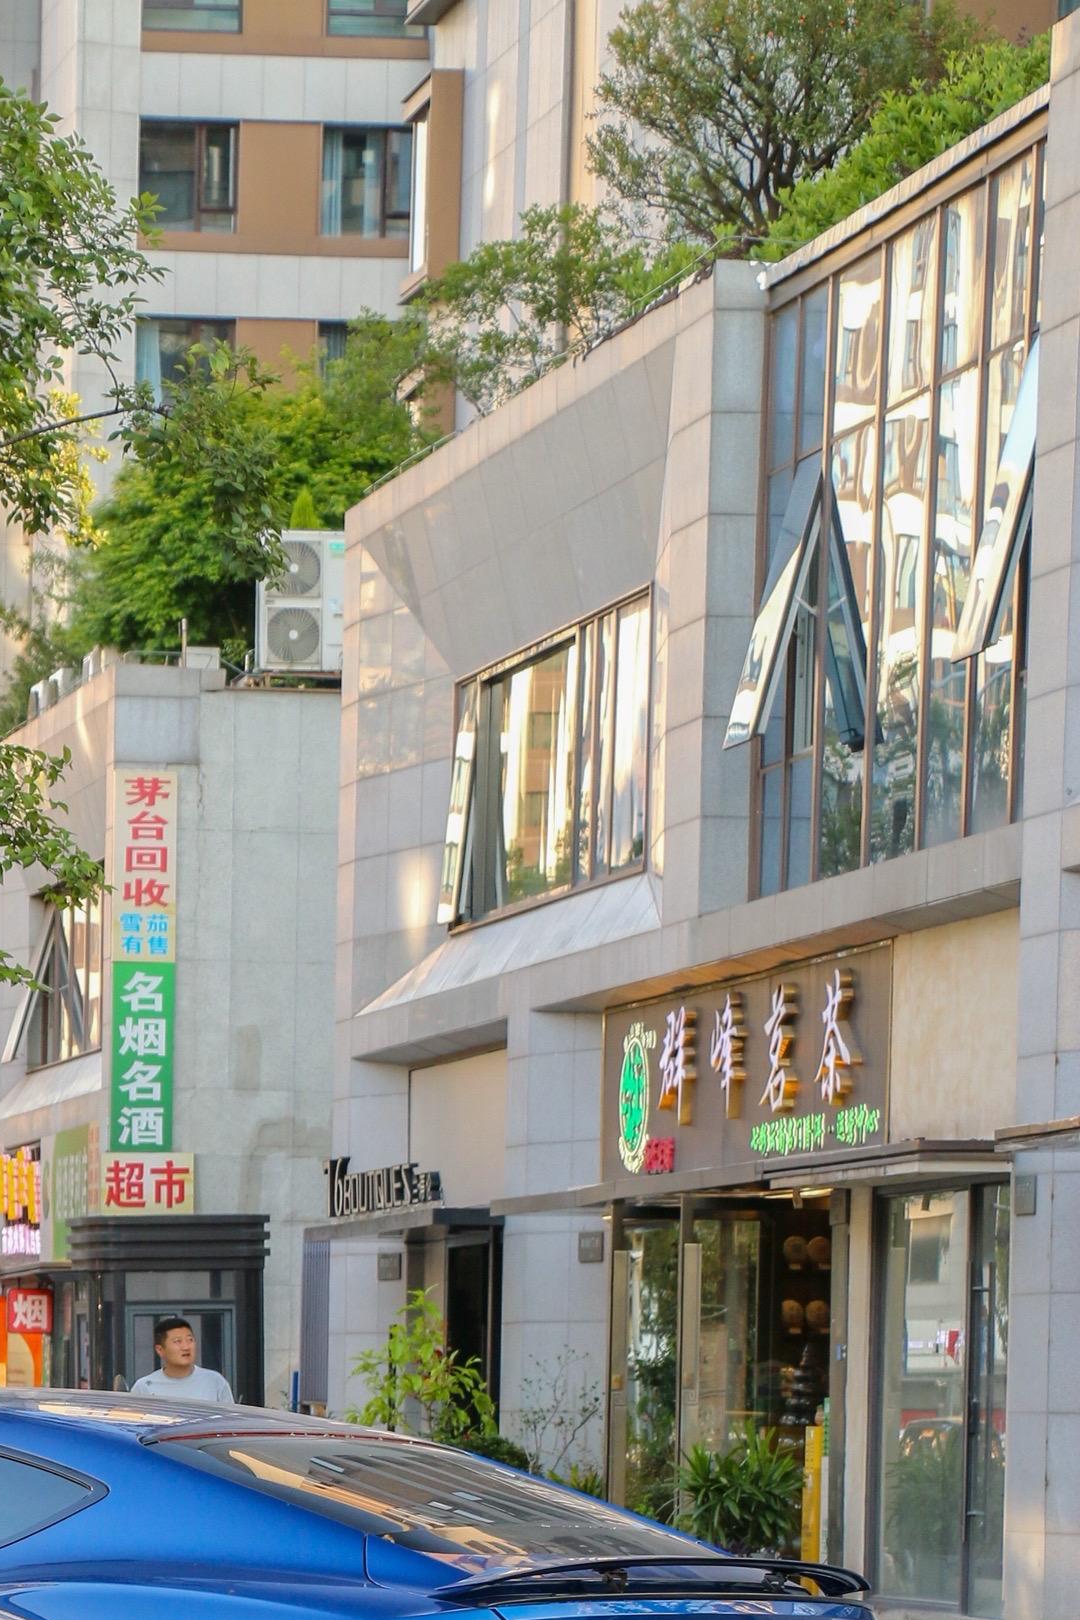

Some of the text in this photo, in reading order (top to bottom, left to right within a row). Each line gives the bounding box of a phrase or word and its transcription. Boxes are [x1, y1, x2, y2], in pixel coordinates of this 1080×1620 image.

[123, 776, 171, 908] 茅台回收
[120, 912, 169, 933] 雪茄
[121, 934, 169, 956] 有售
[118, 971, 167, 1146] 名烟名酒
[104, 1159, 190, 1209] 超市
[12, 1292, 48, 1330] 烟
